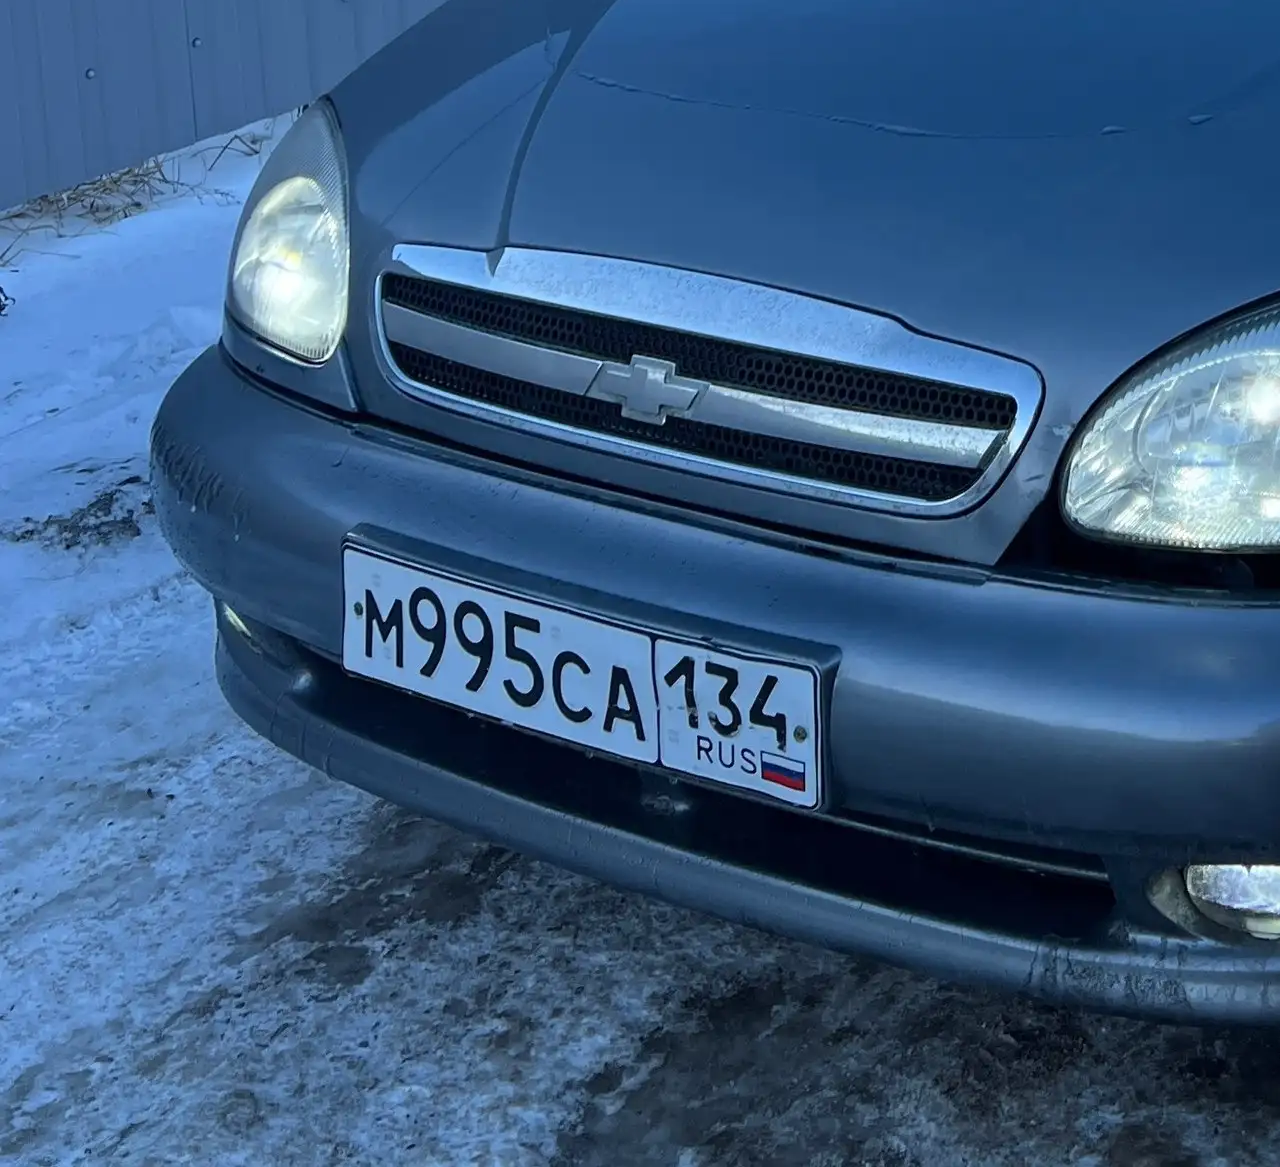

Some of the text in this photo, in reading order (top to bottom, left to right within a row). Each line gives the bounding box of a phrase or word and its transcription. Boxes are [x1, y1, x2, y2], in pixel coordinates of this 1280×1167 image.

[364, 586, 787, 753] М995СА 134
[696, 736, 757, 775] RUS
